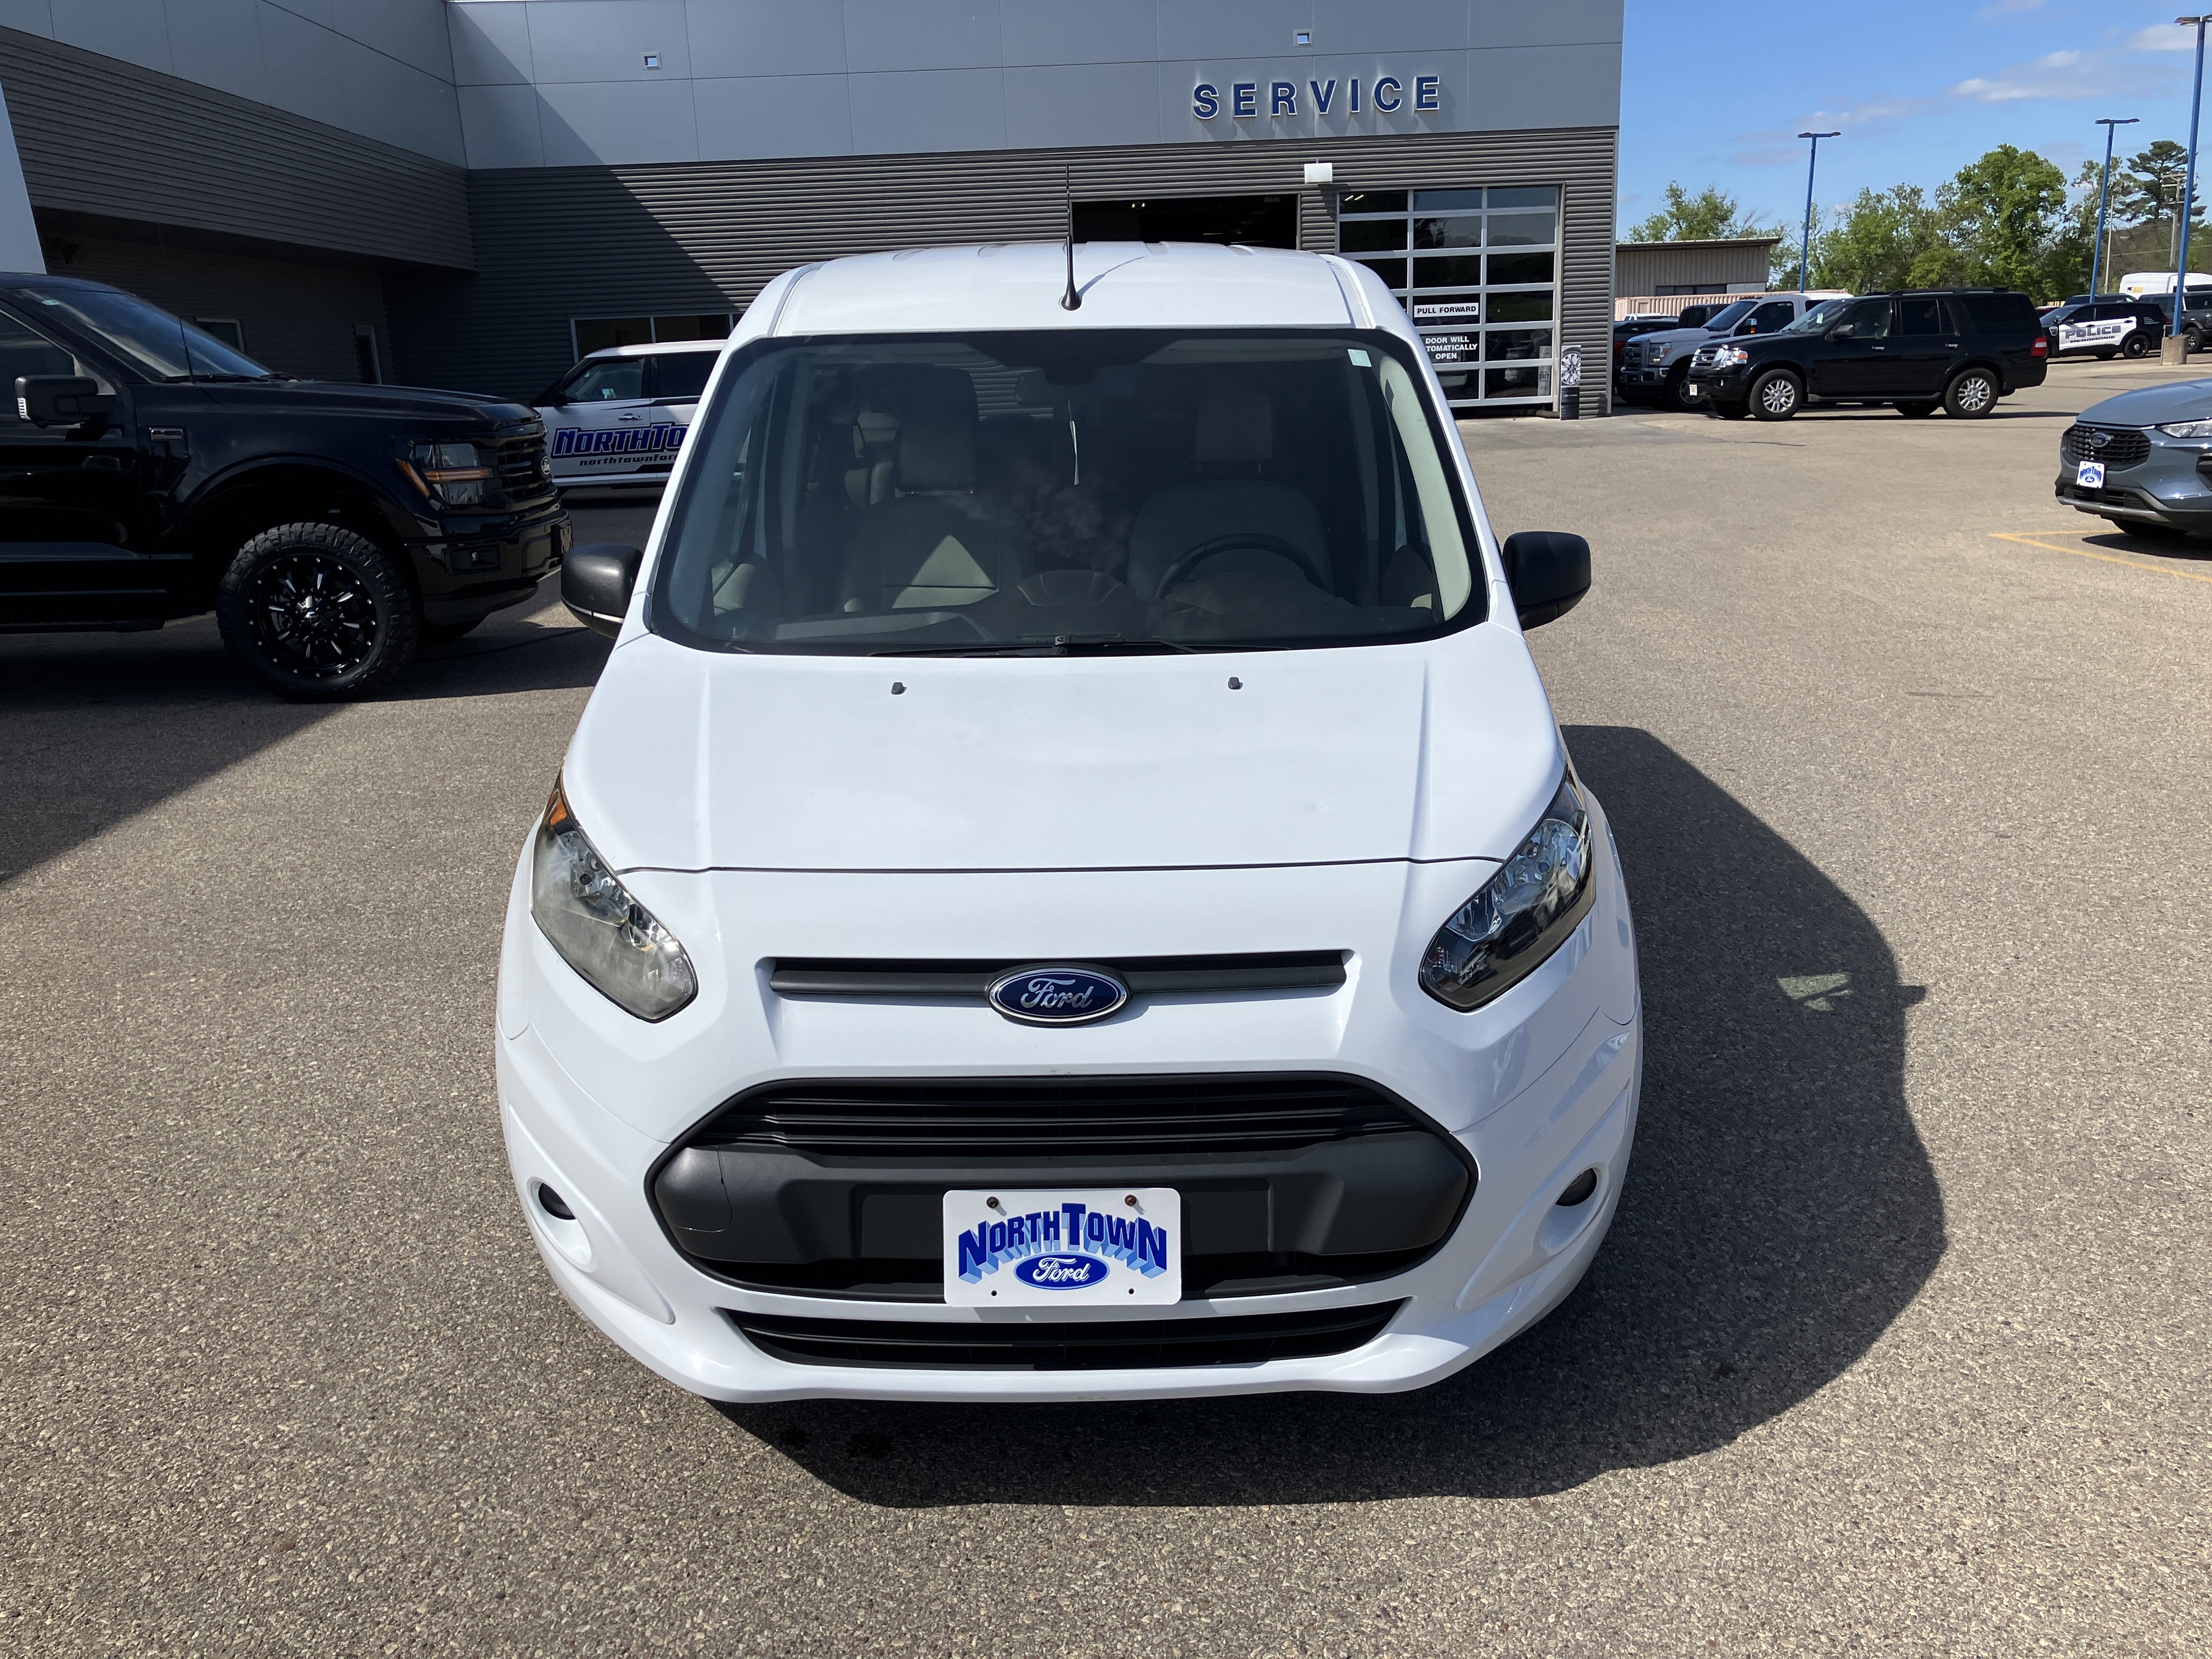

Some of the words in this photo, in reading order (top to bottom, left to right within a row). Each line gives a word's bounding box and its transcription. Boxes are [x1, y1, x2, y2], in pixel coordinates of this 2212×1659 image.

[1193, 76, 1440, 120] SERVICE
[1426, 343, 1477, 352] TOMATICALLY
[552, 423, 689, 456] NORTHTO
[579, 454, 677, 466] northtownfor
[1020, 978, 1094, 1008] Ford
[1033, 1257, 1091, 1282] Ford
